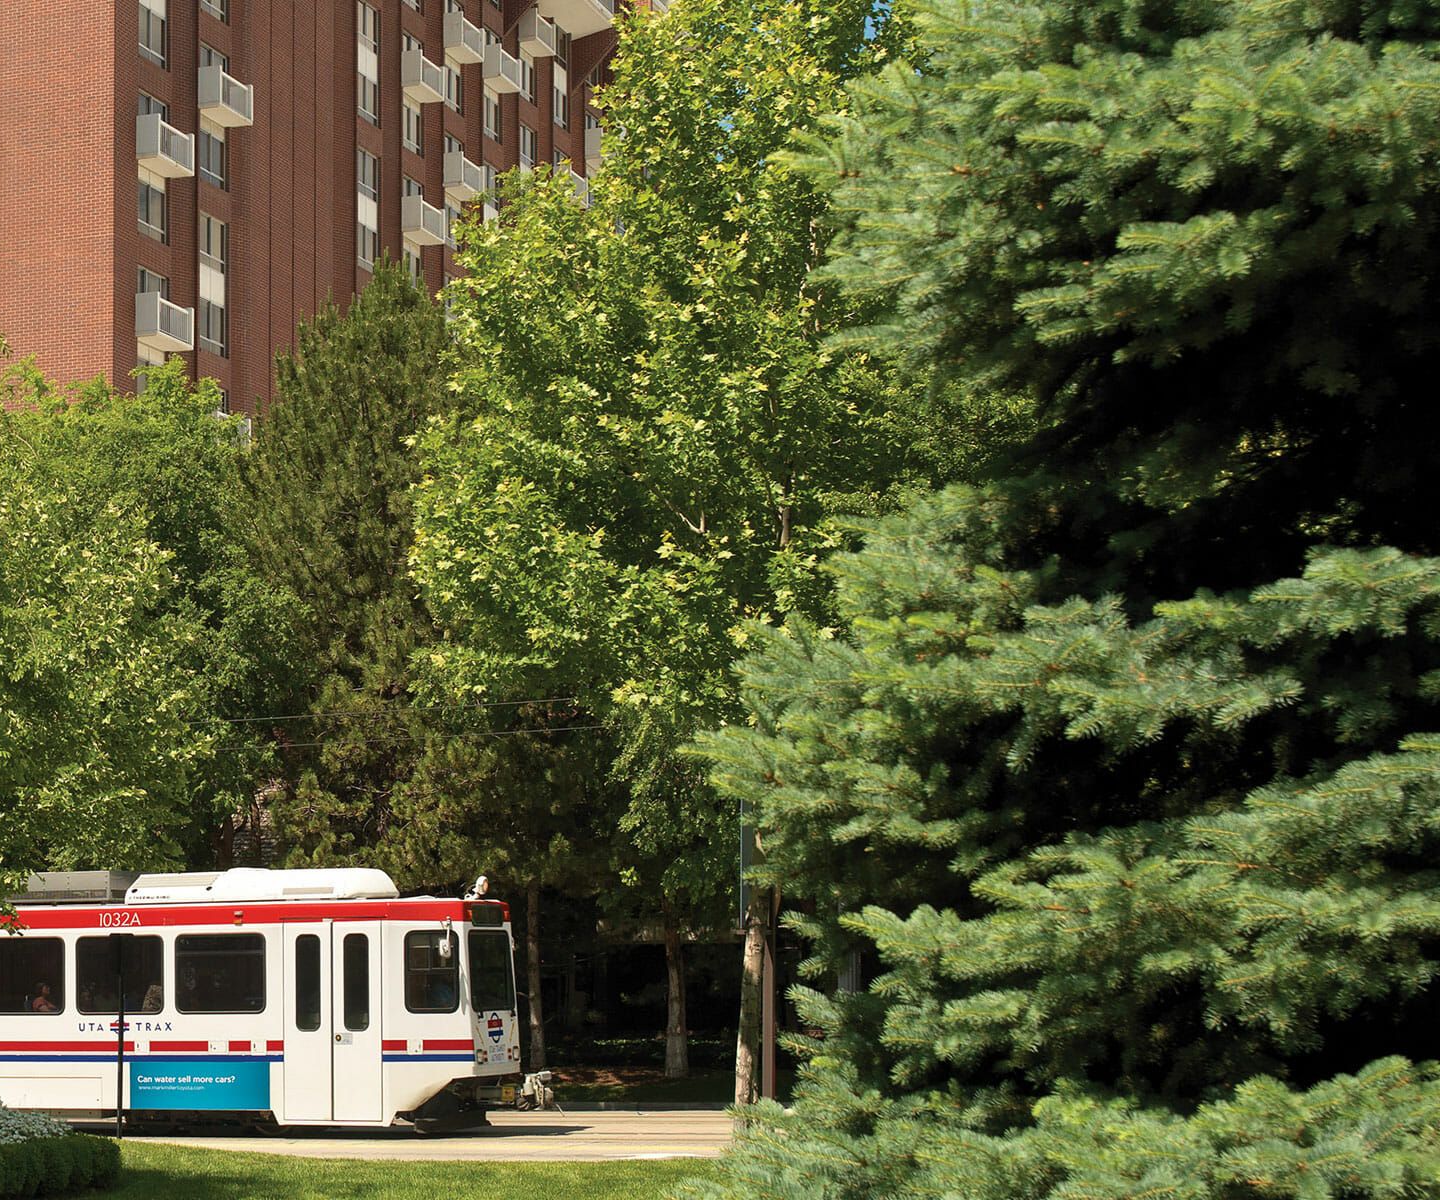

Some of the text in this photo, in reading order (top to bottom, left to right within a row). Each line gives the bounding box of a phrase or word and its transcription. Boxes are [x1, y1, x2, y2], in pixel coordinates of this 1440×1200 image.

[98, 911, 142, 927] 1032A
[78, 1022, 173, 1032] UTA TRAX
[137, 1075, 153, 1083] Can
[177, 1075, 191, 1083] sell
[214, 1075, 236, 1083] cars?
